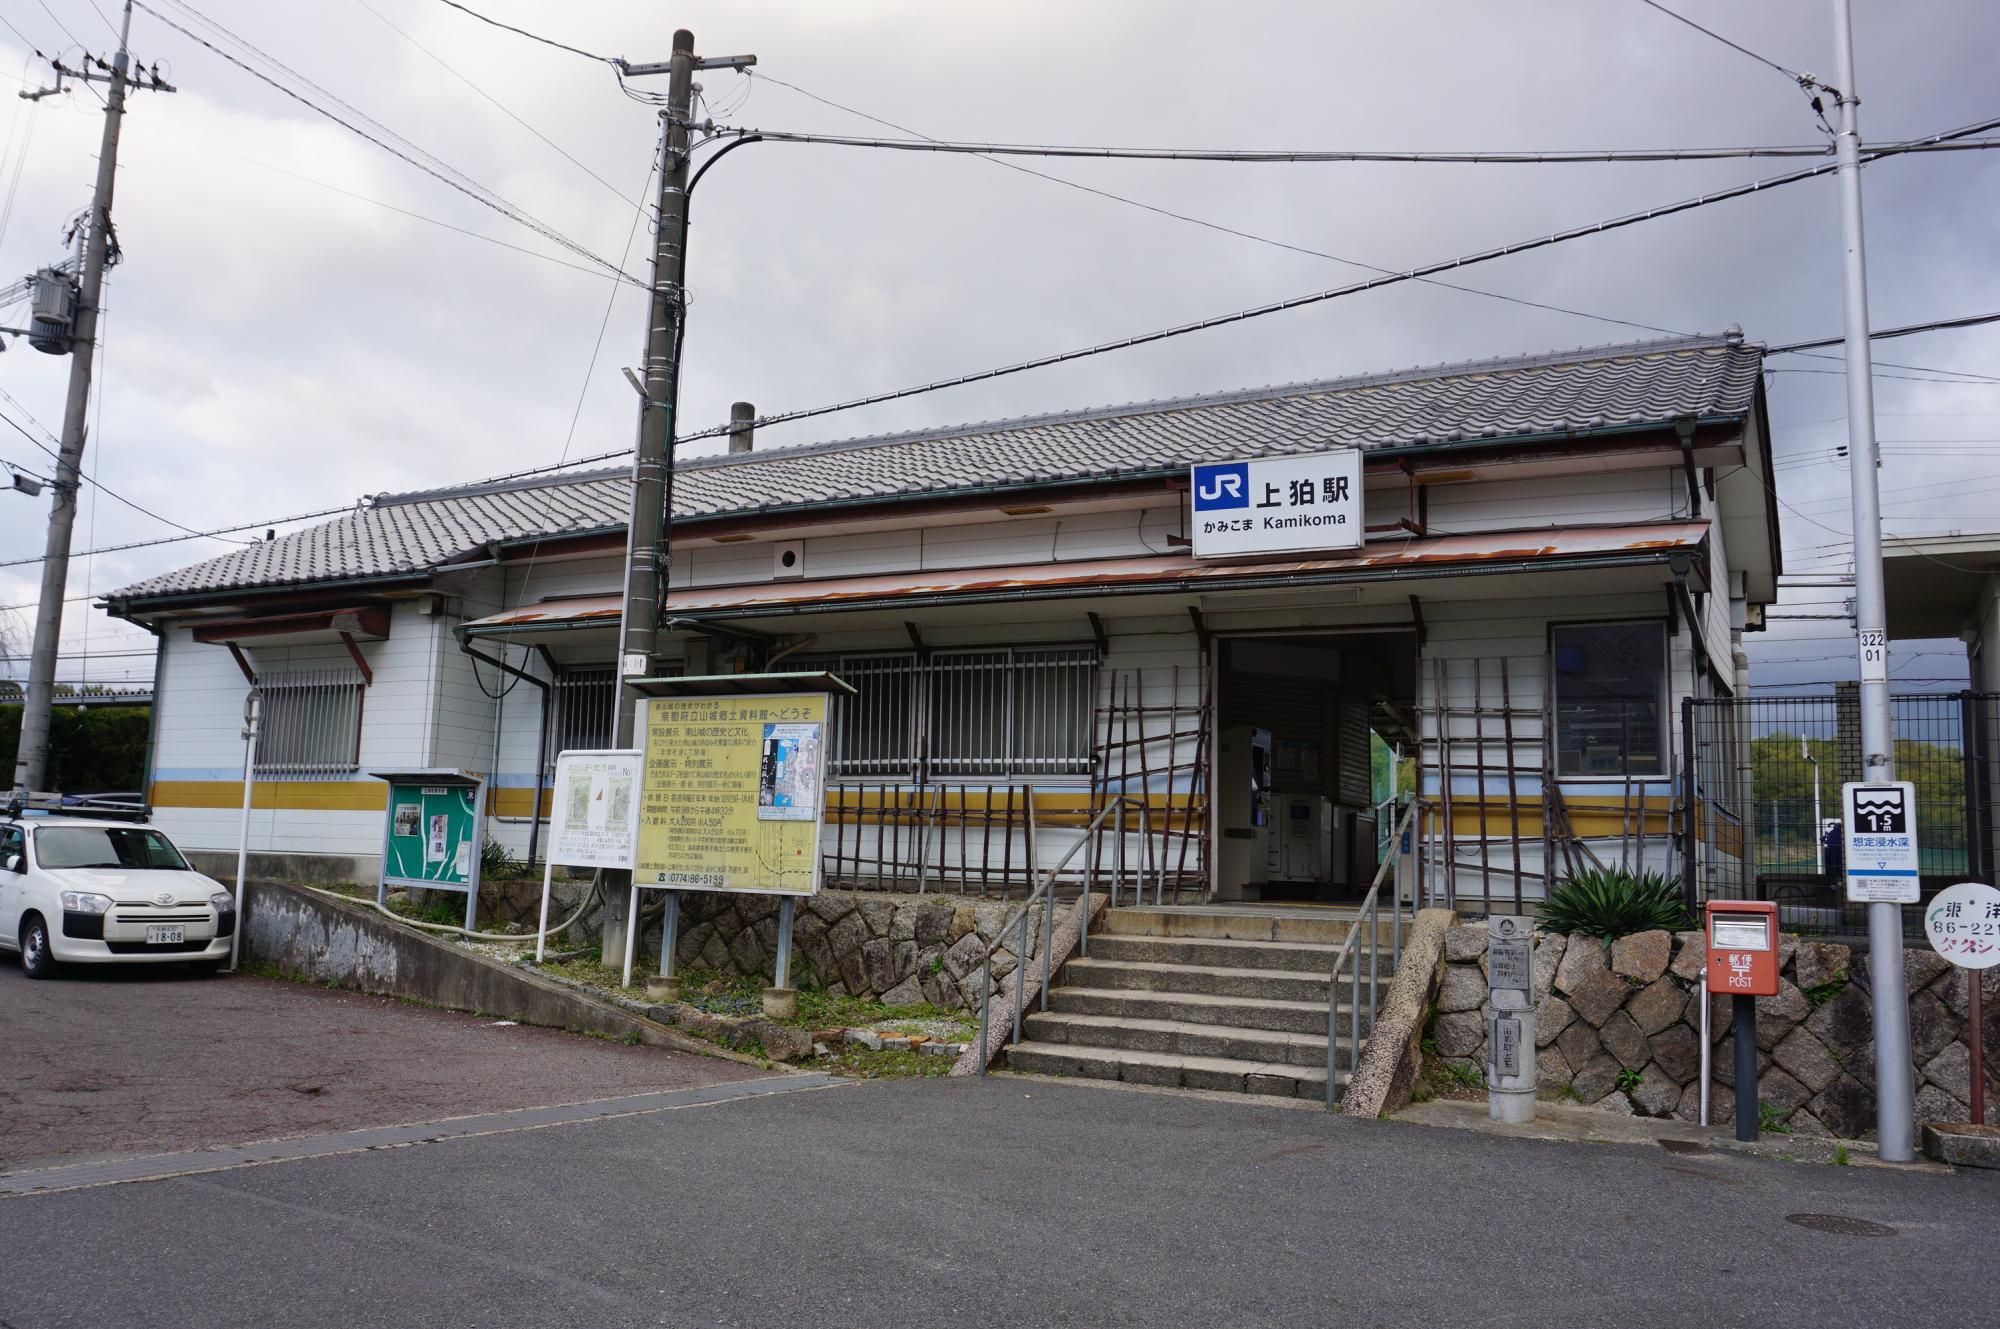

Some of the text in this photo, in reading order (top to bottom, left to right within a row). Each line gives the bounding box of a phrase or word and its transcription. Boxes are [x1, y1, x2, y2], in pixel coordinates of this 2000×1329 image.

[1200, 474, 1242, 500] JR
[1256, 476, 1350, 508] 上狛駅
[1204, 519, 1254, 534] かみこま
[1264, 514, 1346, 530] Kamikoma
[1862, 634, 1884, 646] 322
[1866, 650, 1880, 661] 01
[660, 707, 812, 721] 京都府立山城郷土資料館へどうぞ
[1852, 837, 1910, 847] 想定浸水深
[1728, 953, 1753, 967] 郵便
[1729, 976, 1753, 988] POST
